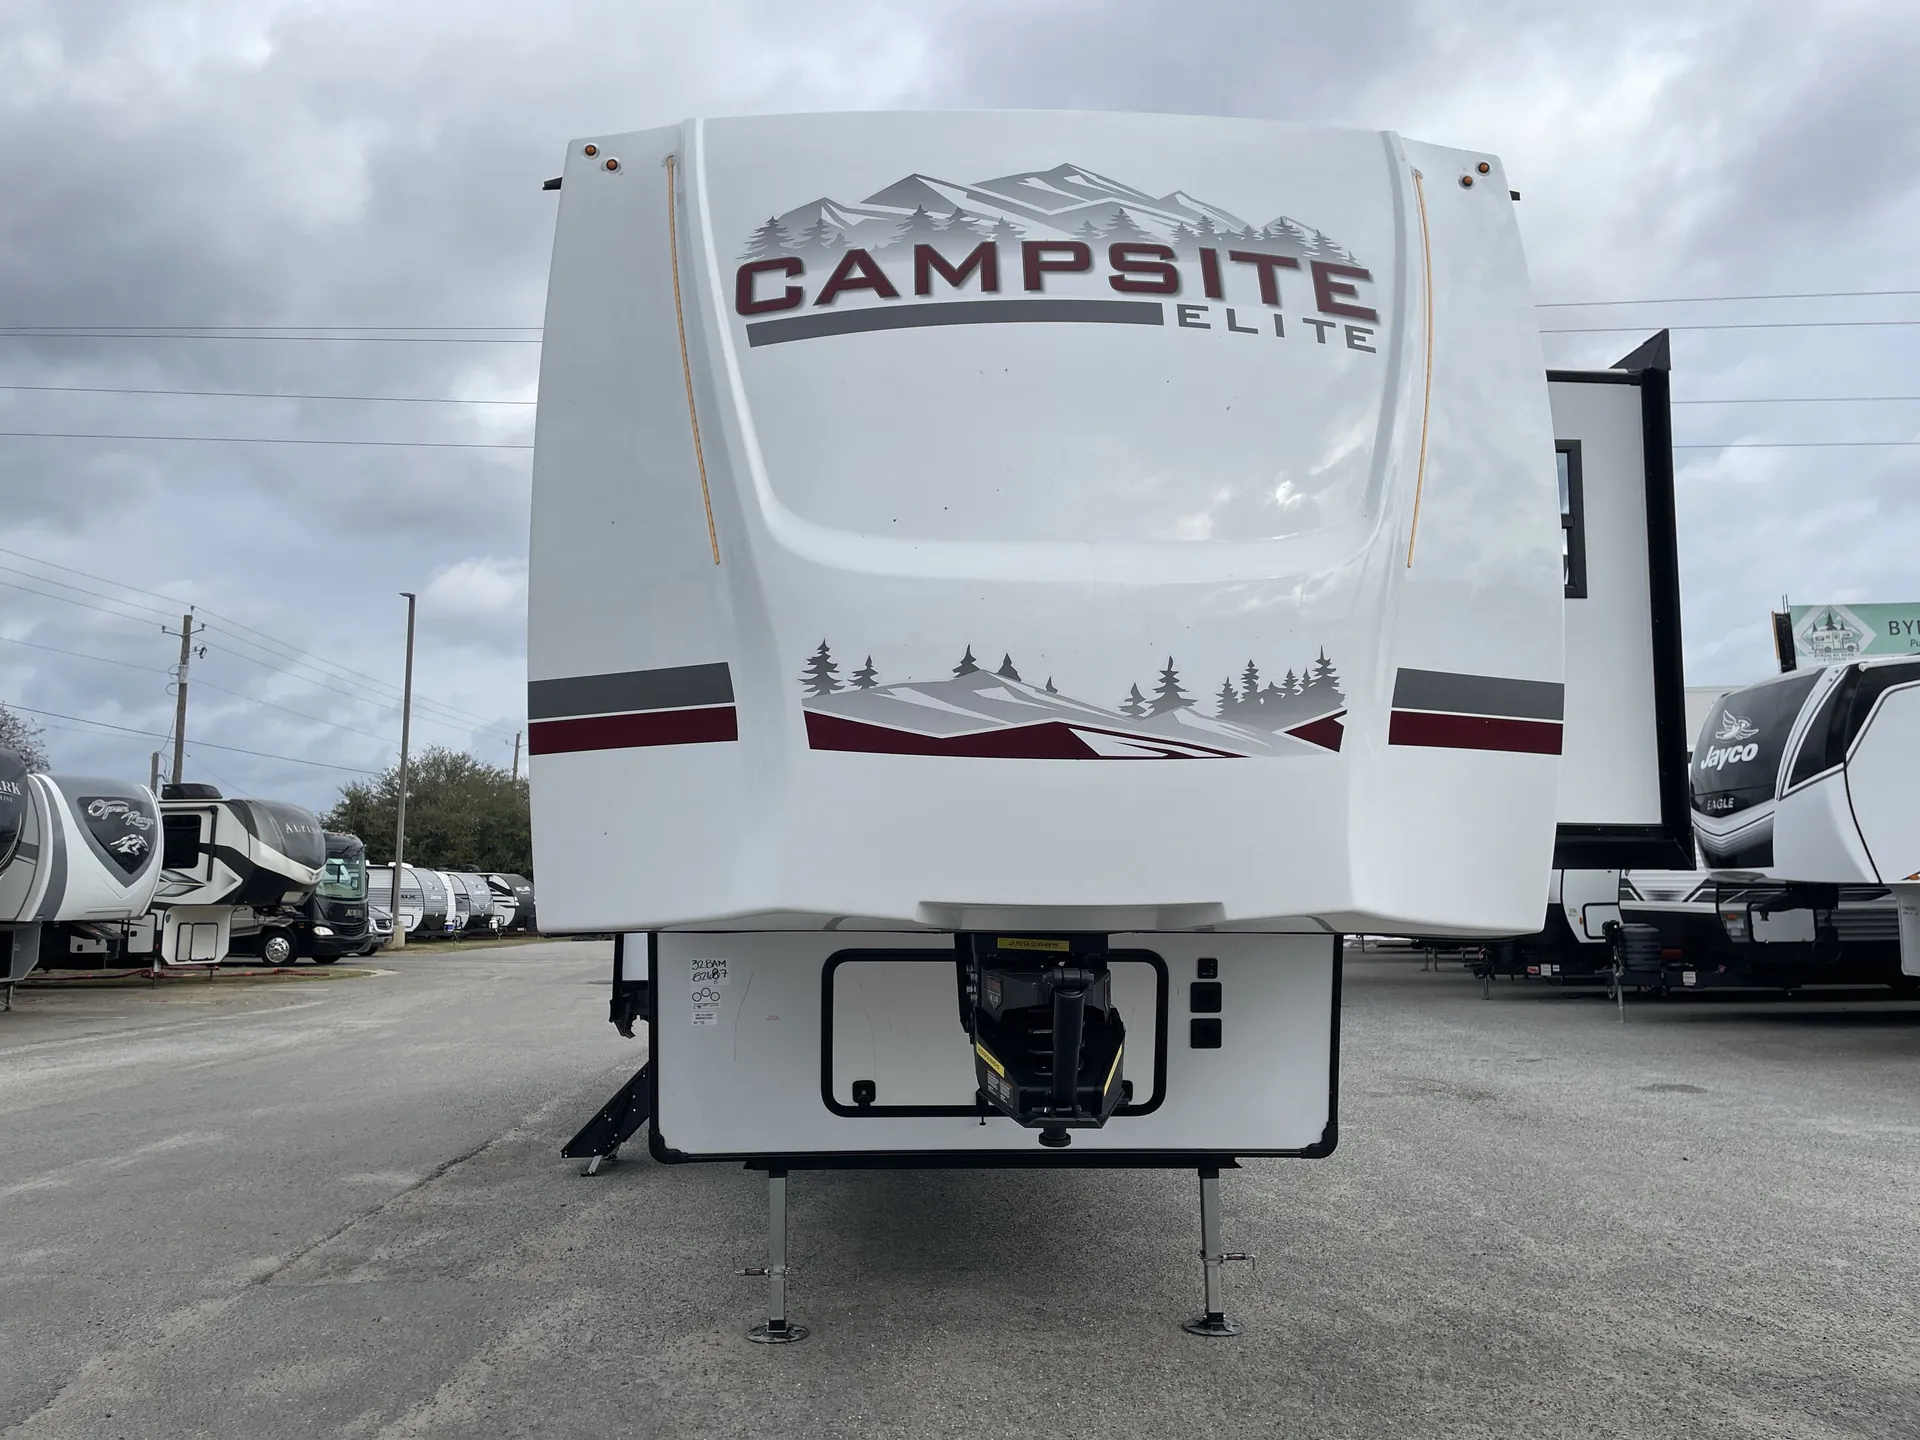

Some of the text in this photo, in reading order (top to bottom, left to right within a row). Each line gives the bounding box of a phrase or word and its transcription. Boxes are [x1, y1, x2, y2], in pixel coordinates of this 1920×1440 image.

[735, 240, 1380, 322] CAMPSITE
[1177, 303, 1378, 354] ELITE
[1700, 743, 1759, 771] Jayco
[0, 781, 22, 796] RK
[1706, 797, 1735, 810] EAGLE
